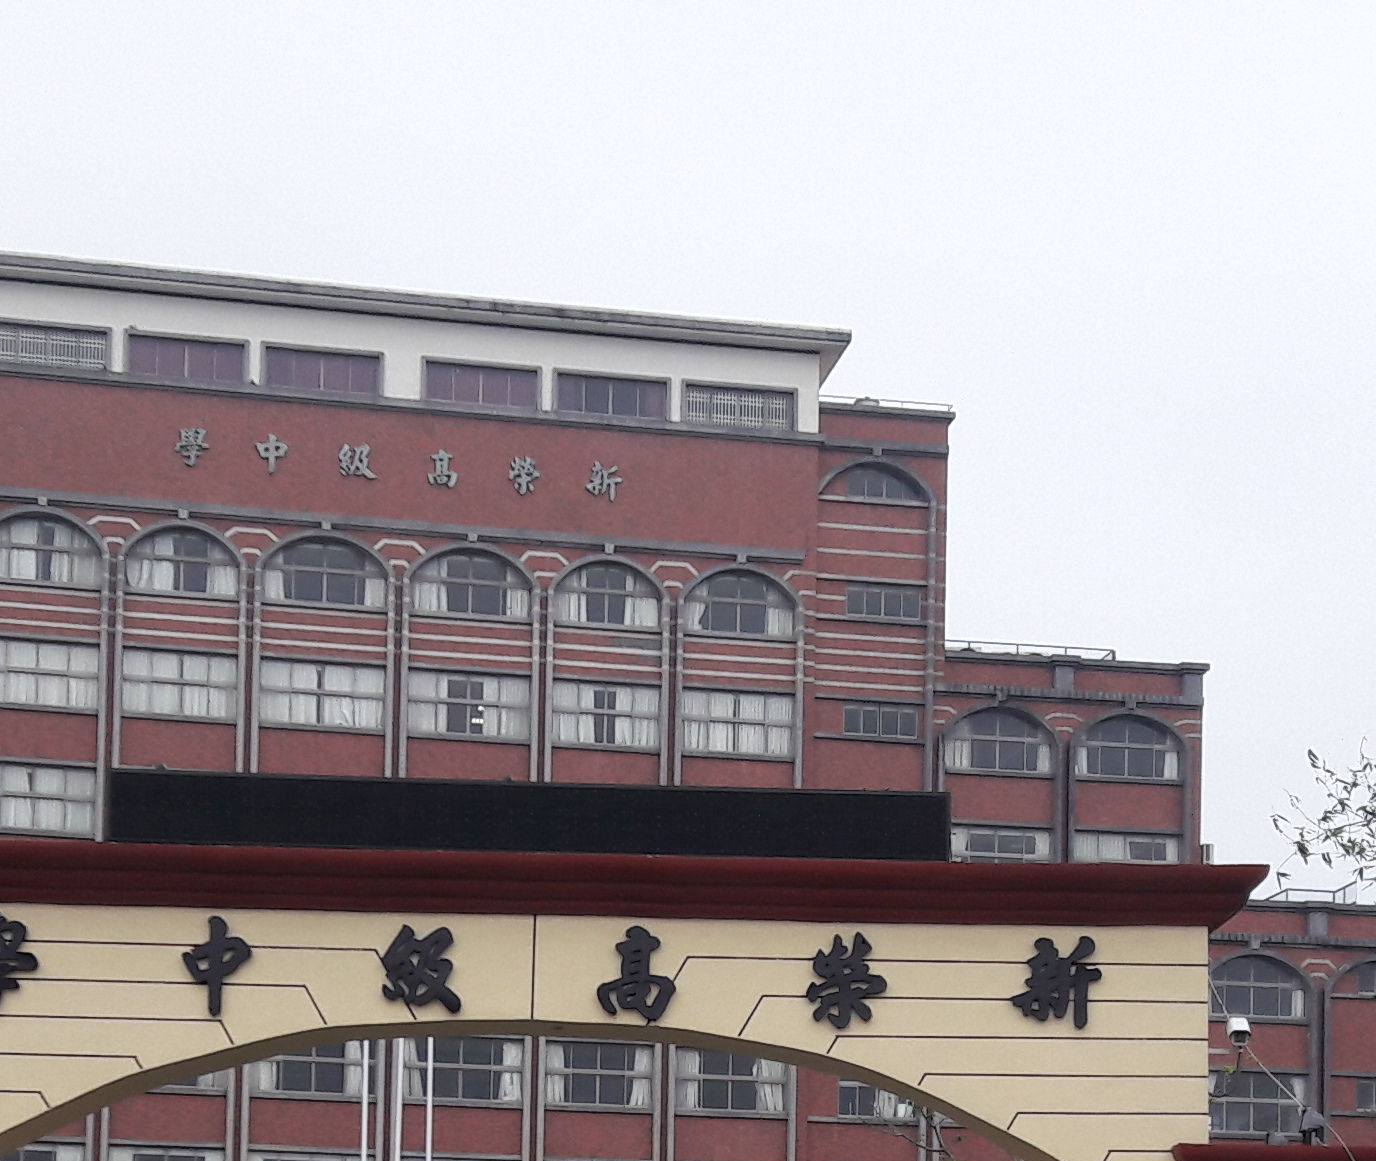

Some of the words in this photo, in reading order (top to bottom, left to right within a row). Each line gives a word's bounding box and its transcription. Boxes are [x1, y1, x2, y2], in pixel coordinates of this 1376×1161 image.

[174, 428, 623, 501] 新榮高級中學
